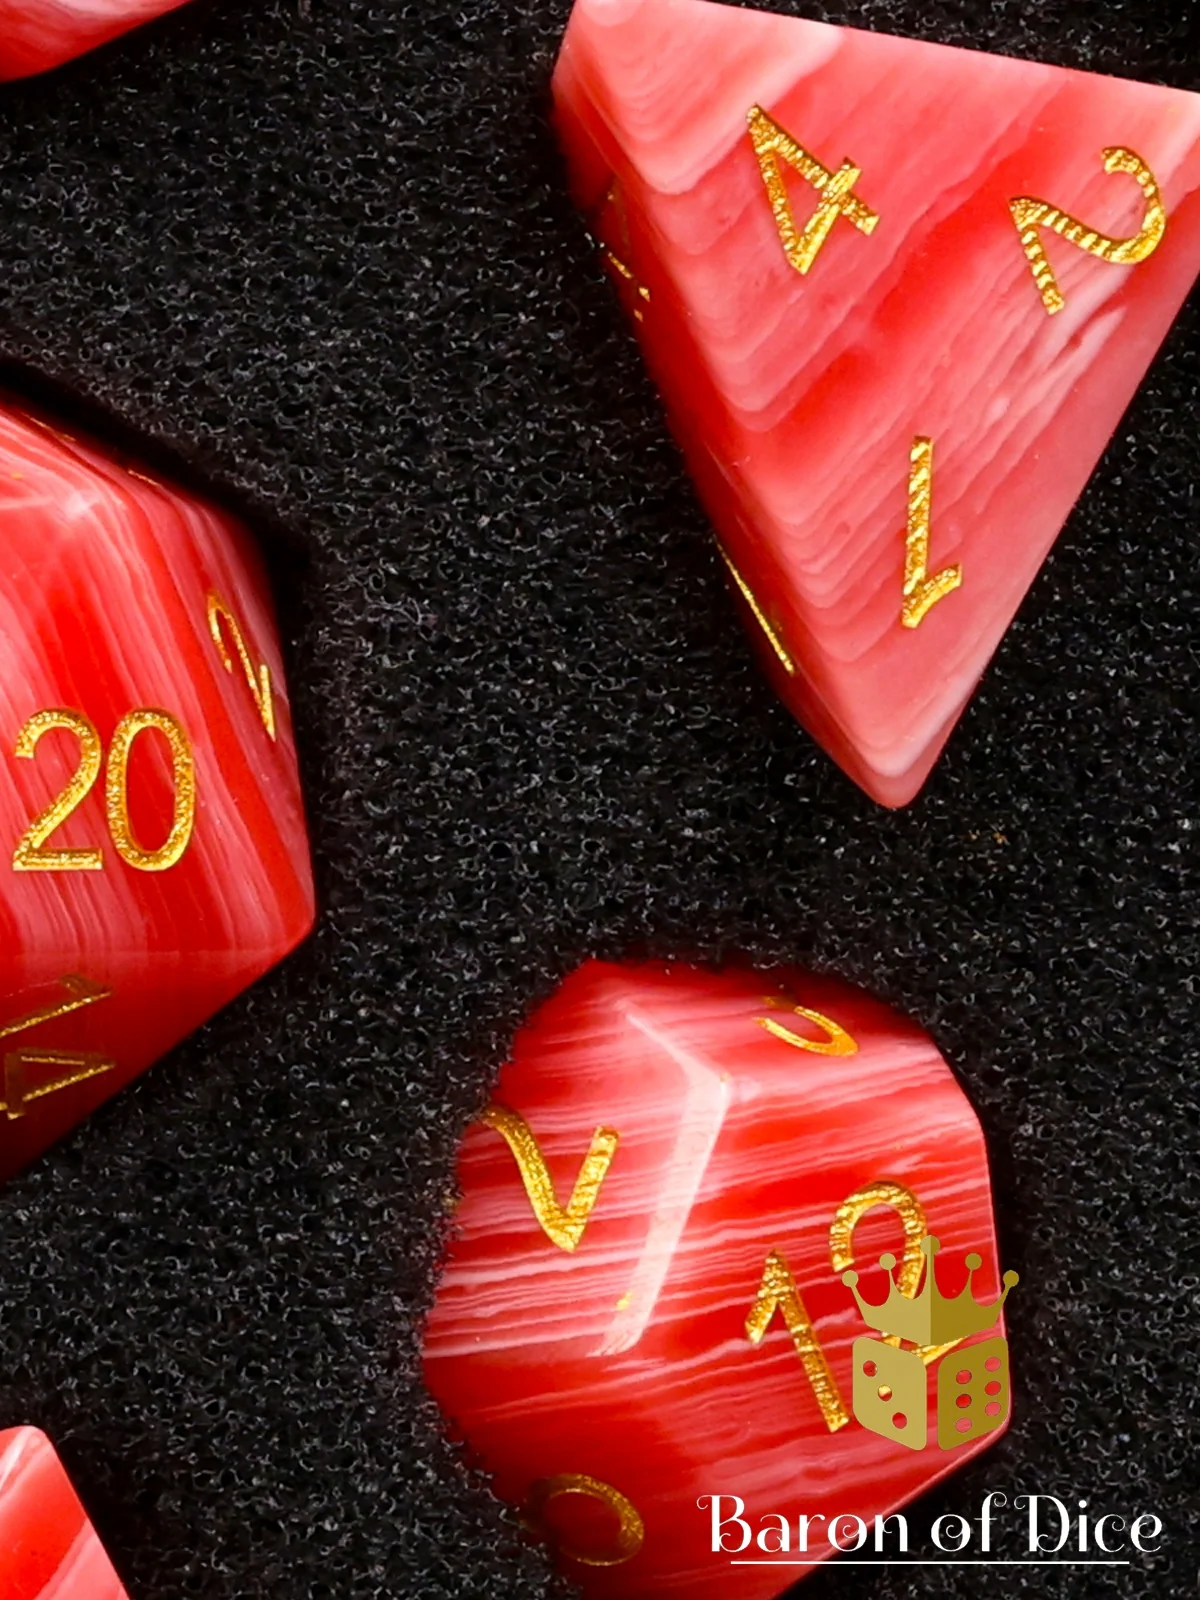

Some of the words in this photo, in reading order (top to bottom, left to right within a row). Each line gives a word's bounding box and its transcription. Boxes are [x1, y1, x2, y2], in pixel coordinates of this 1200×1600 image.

[748, 103, 880, 275] 4
[1009, 145, 1167, 315] 2
[901, 435, 961, 628] 1
[207, 590, 277, 744] 2
[11, 707, 196, 872] 20
